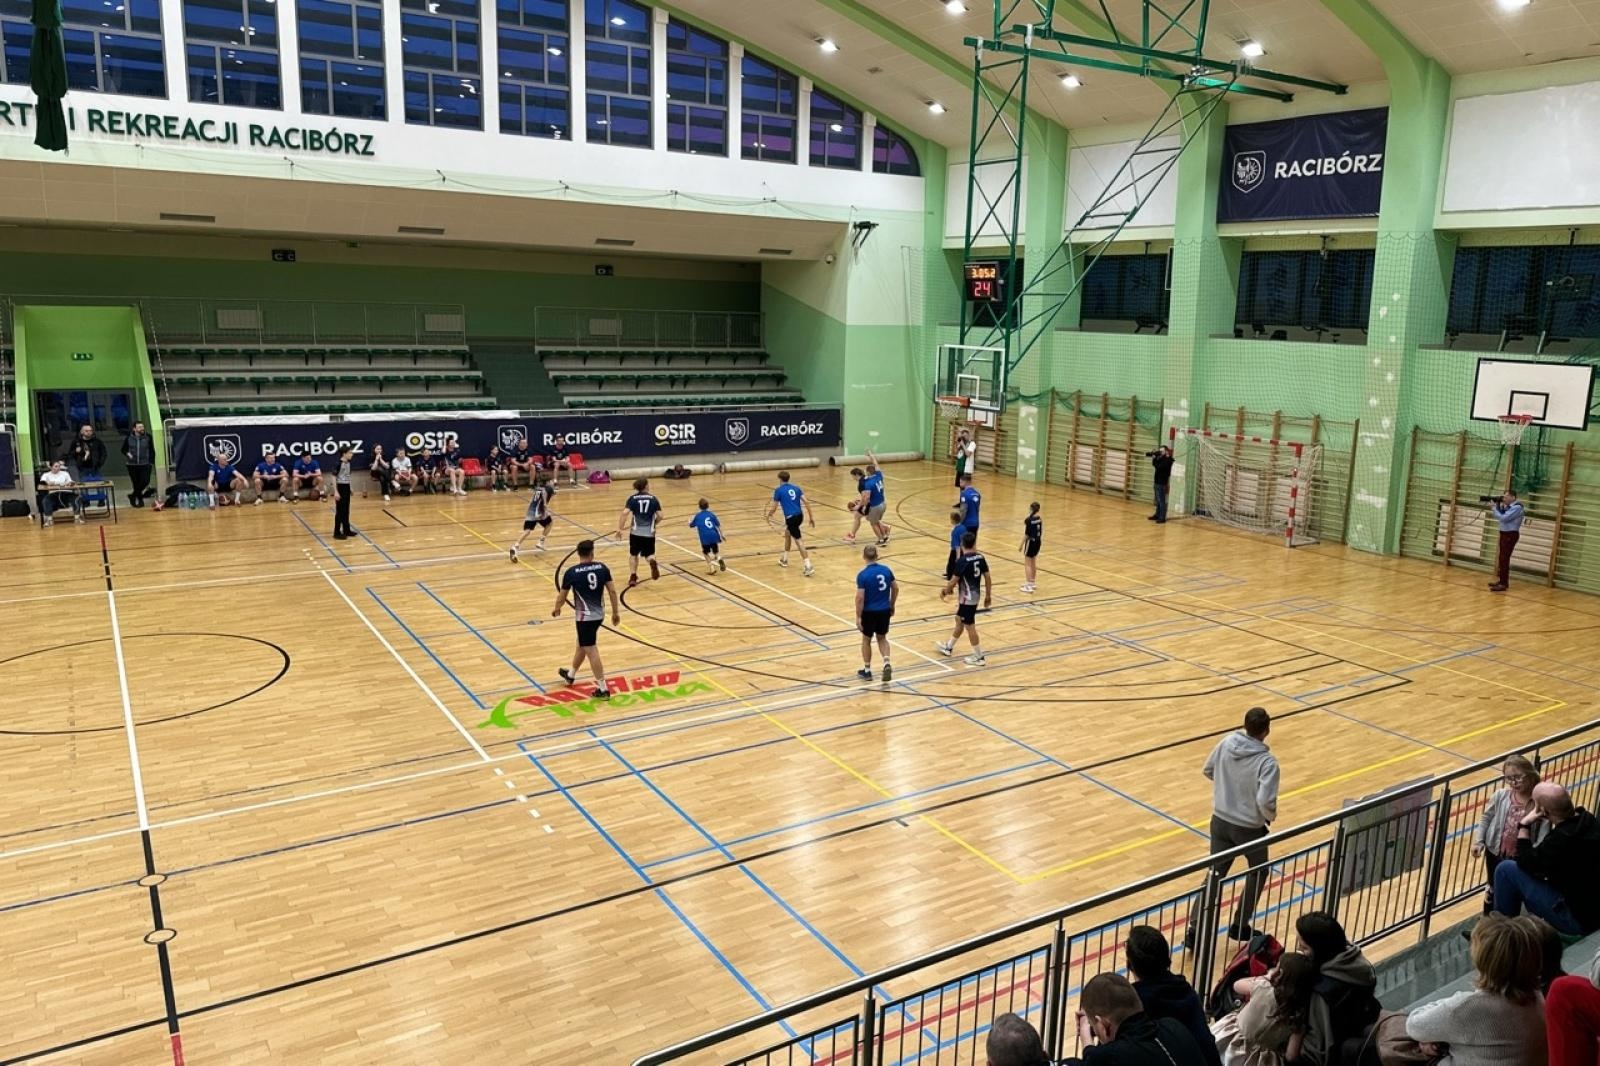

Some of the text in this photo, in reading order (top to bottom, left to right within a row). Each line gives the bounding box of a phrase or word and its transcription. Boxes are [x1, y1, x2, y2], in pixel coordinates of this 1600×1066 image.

[0, 101, 375, 156] RT I REKREACJI RACIBÓRZ
[1274, 151, 1383, 179] RACIBÓRZ
[974, 281, 990, 297] 24
[654, 423, 697, 440] OSiR
[760, 421, 824, 437] RACIBÓRZ
[788, 489, 797, 500] 9
[638, 499, 650, 513] 17
[704, 517, 714, 529] 6
[973, 561, 981, 577] 5
[587, 572, 598, 590] 9
[876, 574, 887, 591] 3
